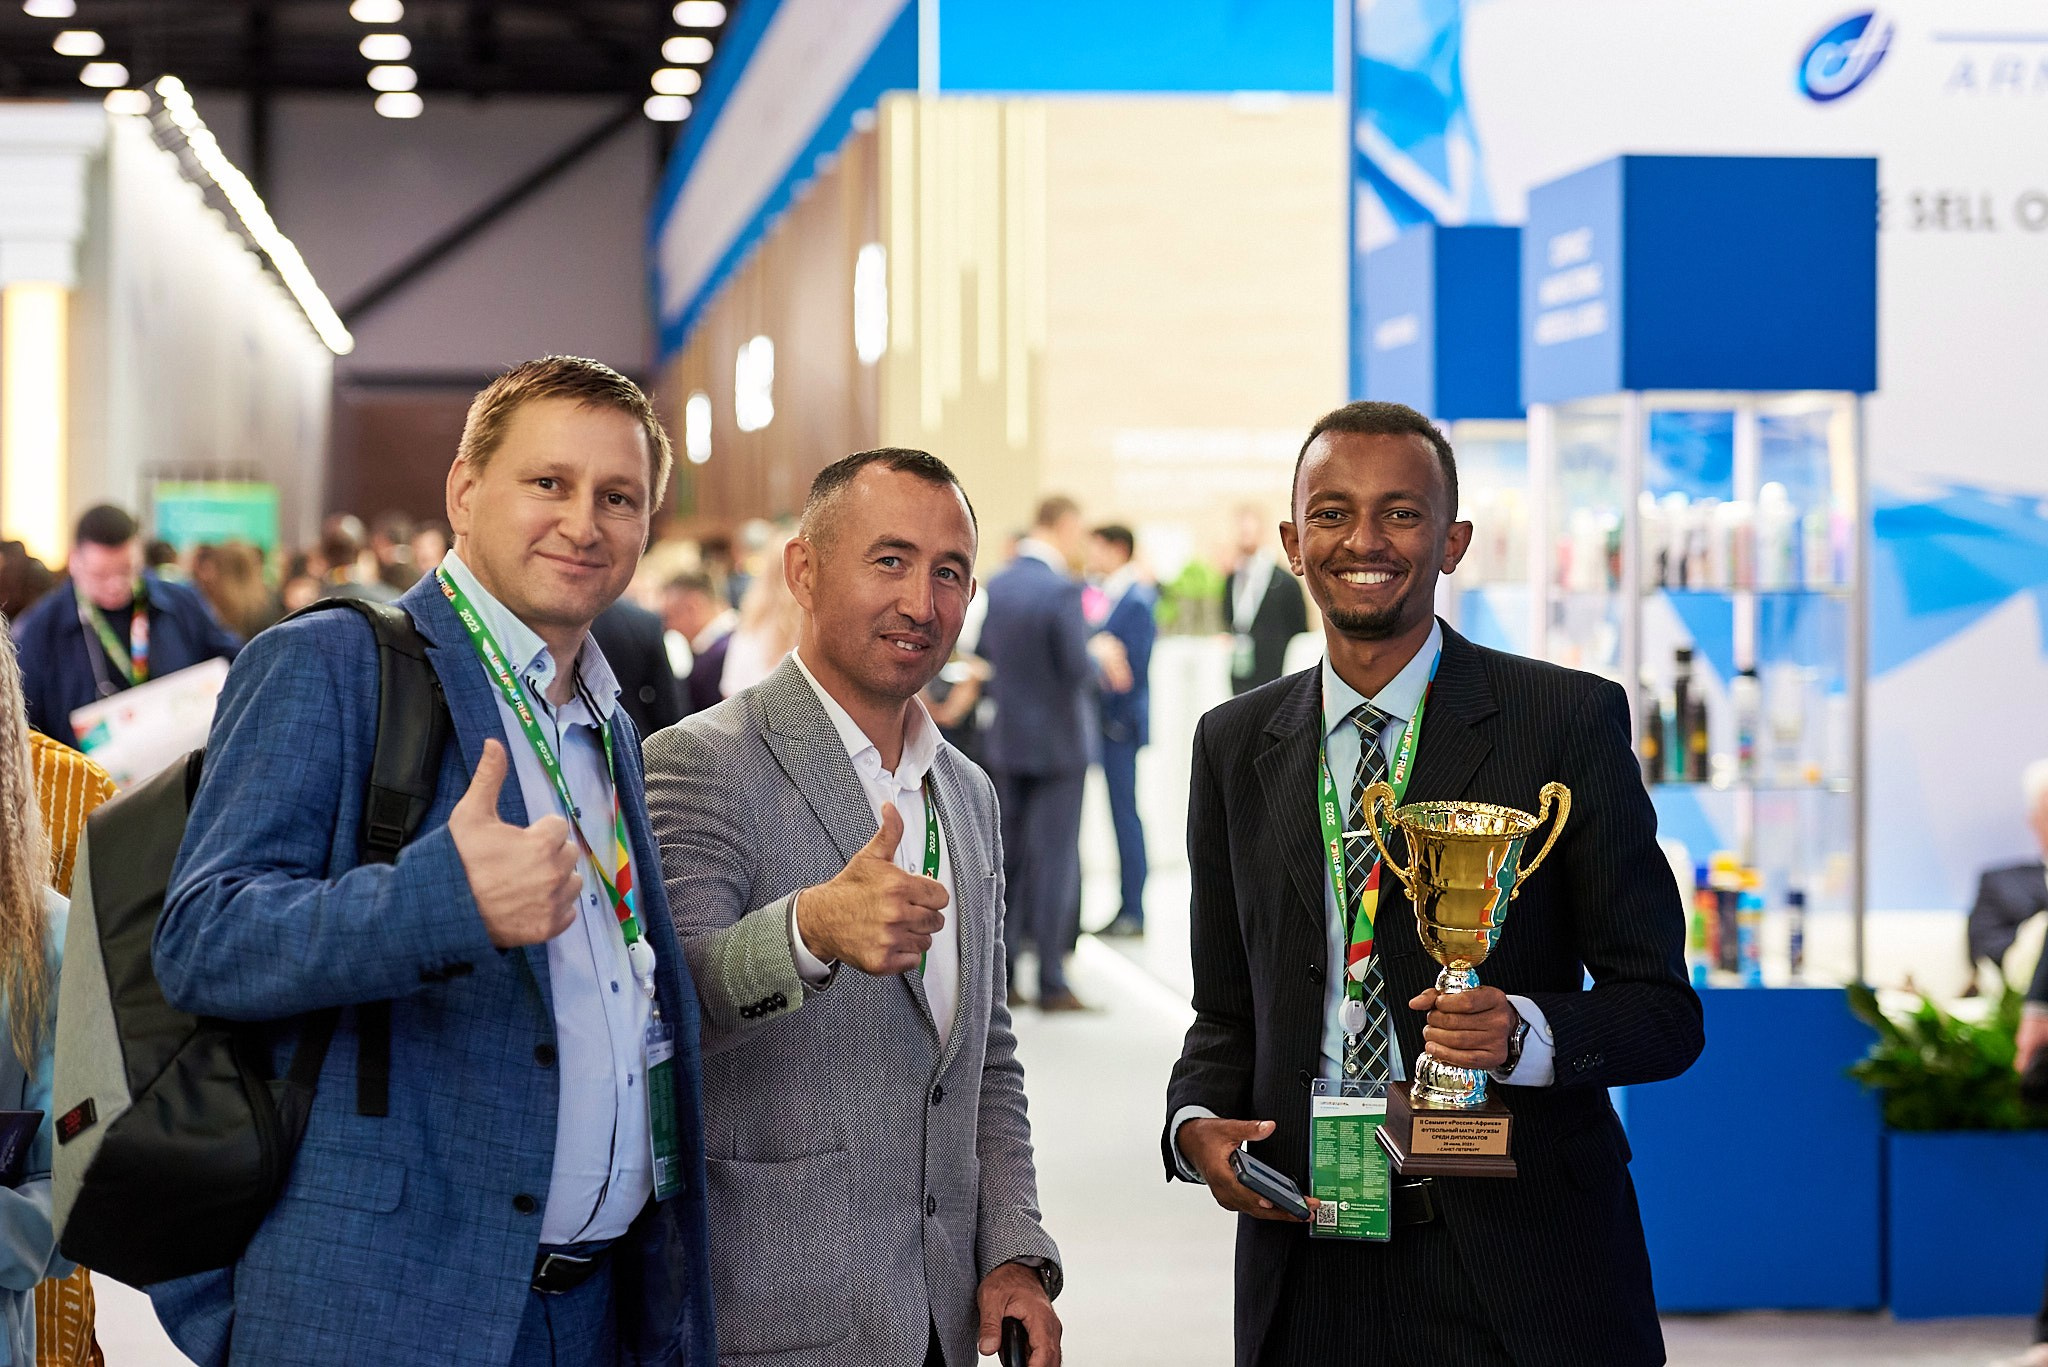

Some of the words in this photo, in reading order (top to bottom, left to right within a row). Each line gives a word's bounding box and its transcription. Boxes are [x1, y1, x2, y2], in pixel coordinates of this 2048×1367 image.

[1908, 188, 1996, 232] SELL
[459, 608, 481, 634] 2023
[536, 740, 554, 767] 2023
[1325, 801, 1336, 827] 2023
